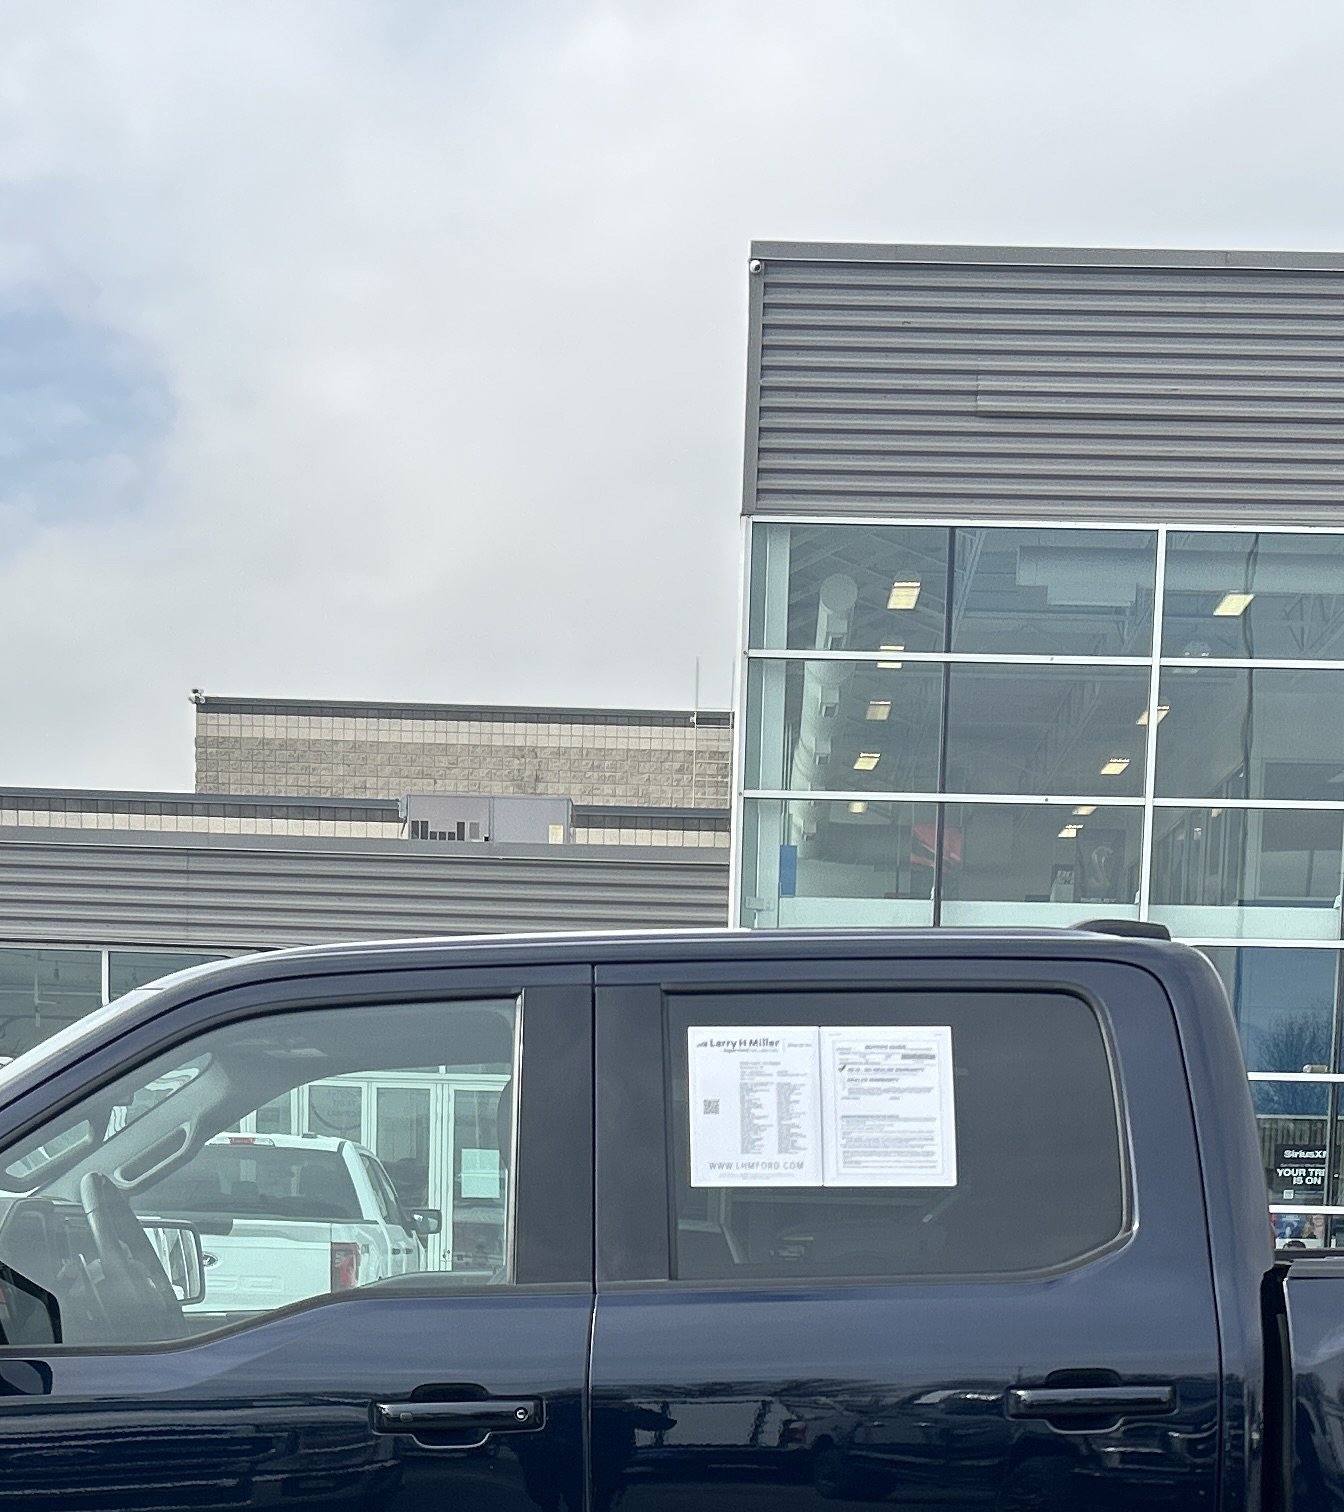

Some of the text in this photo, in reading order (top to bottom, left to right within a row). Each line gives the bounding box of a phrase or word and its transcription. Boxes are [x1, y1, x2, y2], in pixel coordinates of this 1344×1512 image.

[709, 1038, 737, 1050] Larry
[739, 1038, 747, 1047] H
[748, 1037, 781, 1047] Miller
[1276, 1168, 1306, 1177] YOUR
[1292, 1176, 1322, 1185] IS ON
